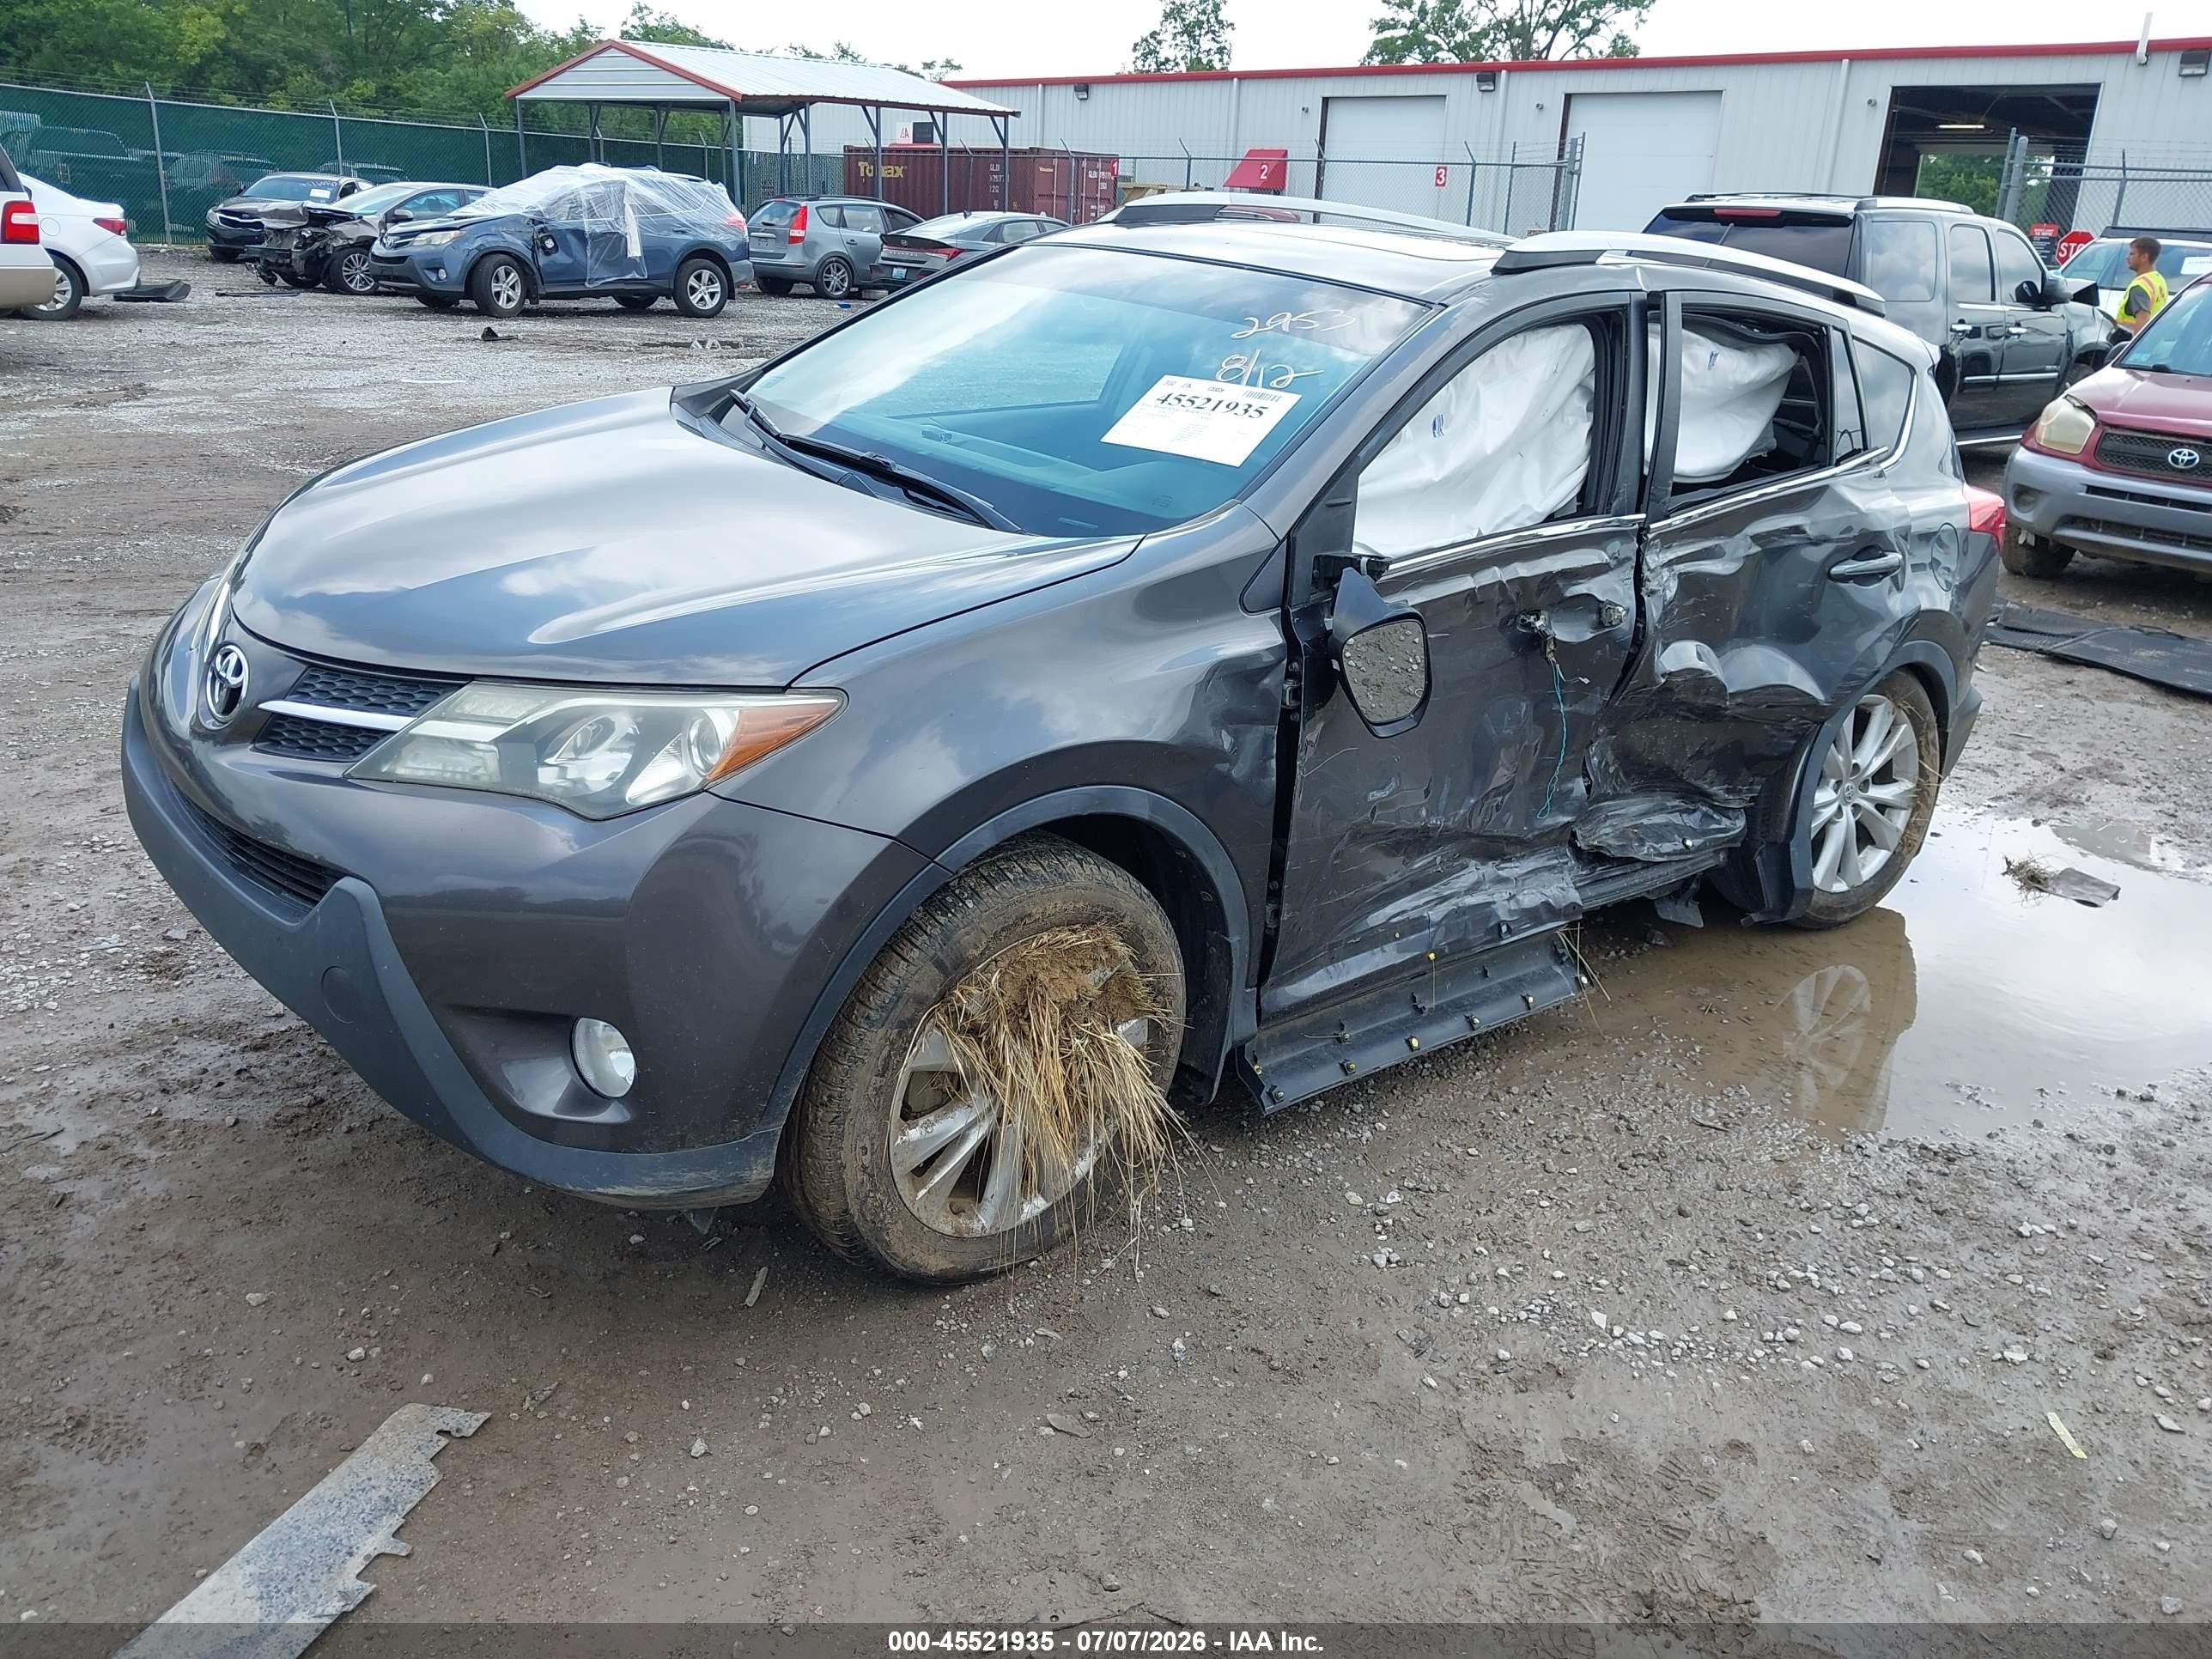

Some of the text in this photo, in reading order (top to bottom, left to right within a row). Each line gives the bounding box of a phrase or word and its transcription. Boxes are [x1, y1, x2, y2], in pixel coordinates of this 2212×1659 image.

[1112, 161, 1118, 175] 1
[1260, 164, 1268, 179] 2
[1436, 168, 1445, 185] 3
[1230, 309, 1357, 340] 2953
[1215, 349, 1325, 389] 8/12
[1156, 392, 1269, 419] 45521935
